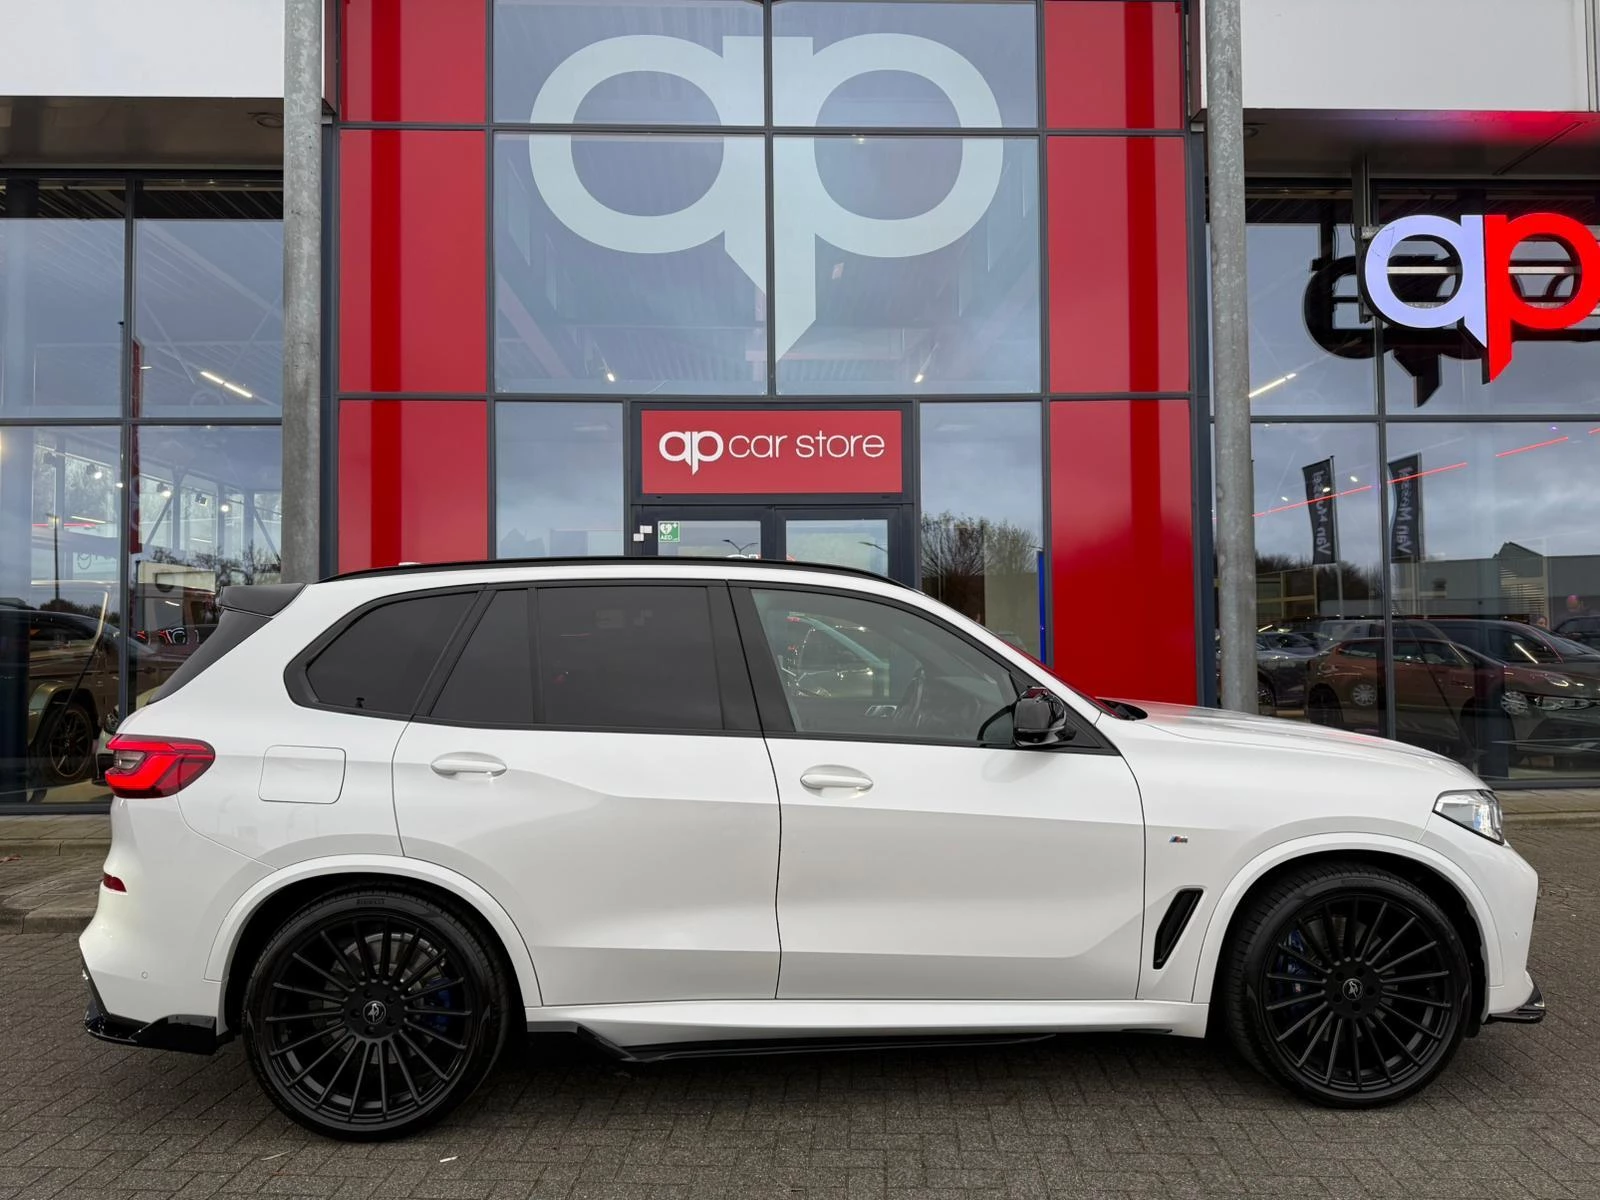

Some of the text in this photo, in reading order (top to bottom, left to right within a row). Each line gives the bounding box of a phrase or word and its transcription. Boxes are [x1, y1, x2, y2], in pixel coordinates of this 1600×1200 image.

[529, 33, 1004, 363] ap
[1365, 212, 1600, 383] ap
[658, 430, 885, 476] ap car store
